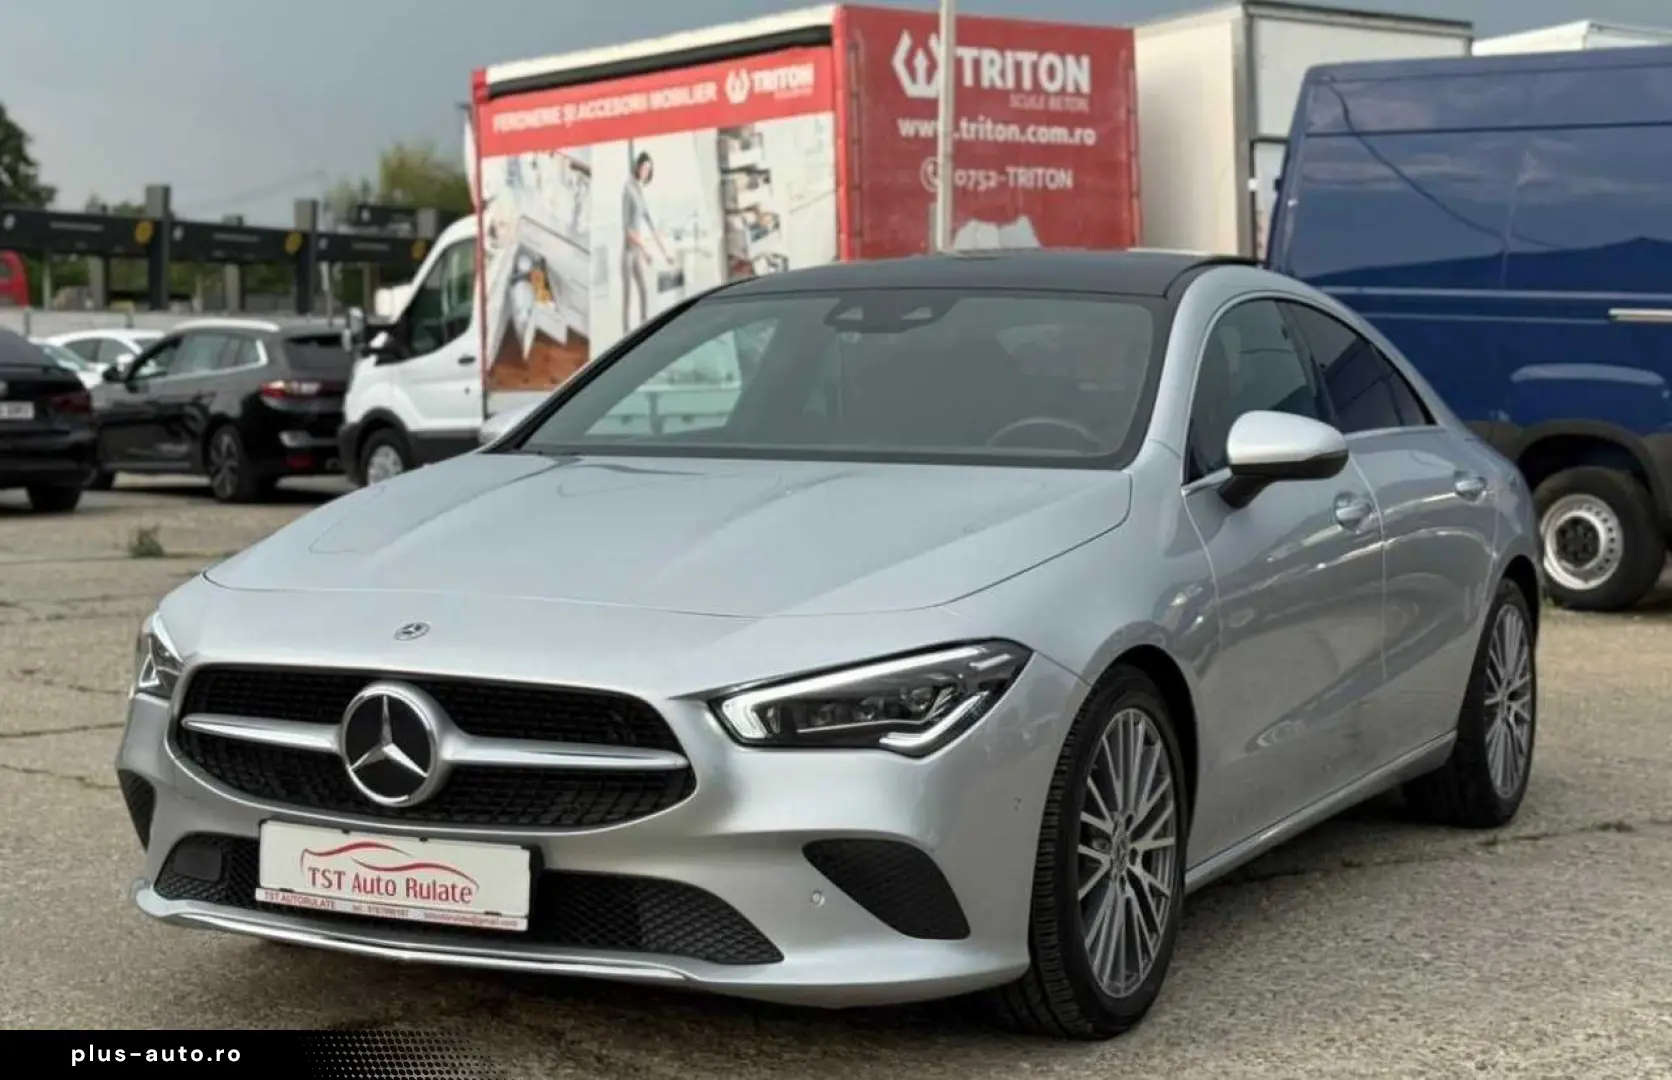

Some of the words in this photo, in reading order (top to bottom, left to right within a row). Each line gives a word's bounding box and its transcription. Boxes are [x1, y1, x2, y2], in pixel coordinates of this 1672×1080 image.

[751, 63, 815, 94] TRITON
[955, 46, 1091, 94] TRITON
[308, 866, 345, 891] TST
[352, 874, 397, 898] Auto
[405, 877, 473, 904] Rulate
